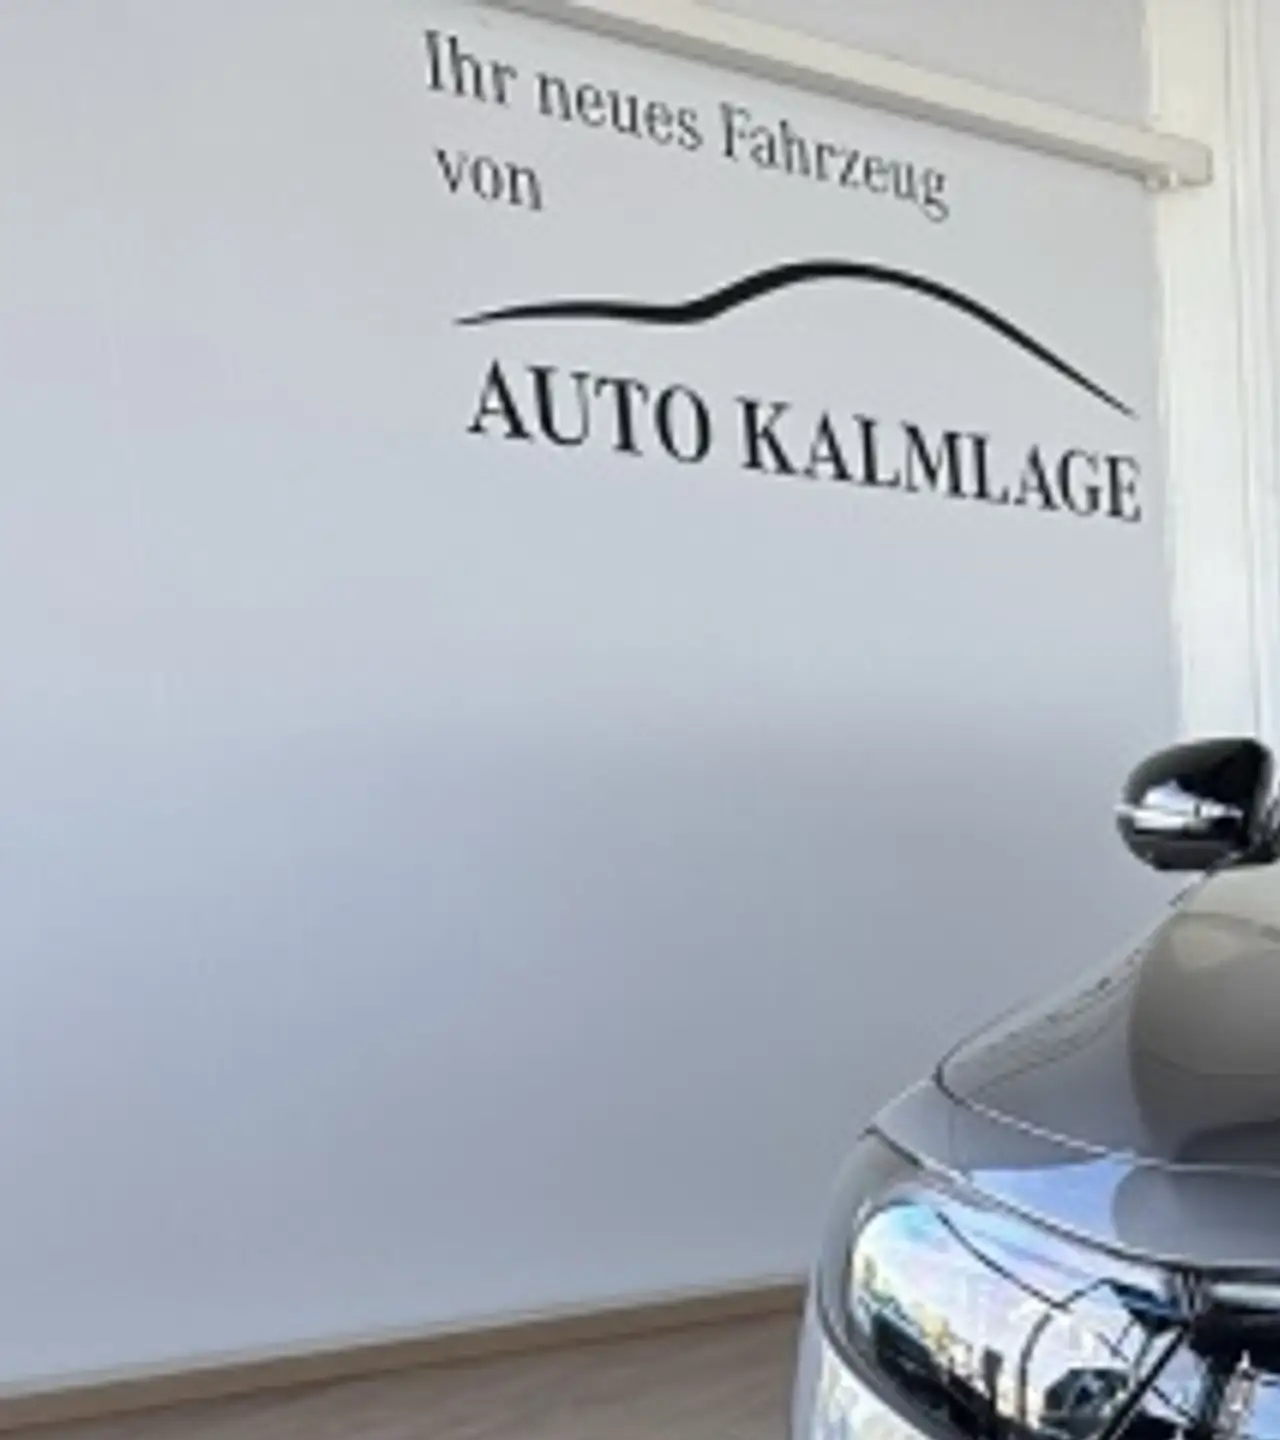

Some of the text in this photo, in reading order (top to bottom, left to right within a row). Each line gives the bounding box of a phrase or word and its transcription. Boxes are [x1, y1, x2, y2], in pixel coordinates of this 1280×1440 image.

[423, 29, 950, 223] Ihr neues Fahrzeug
[435, 147, 544, 210] von
[466, 359, 1142, 522] AUTO KALMLAGE
